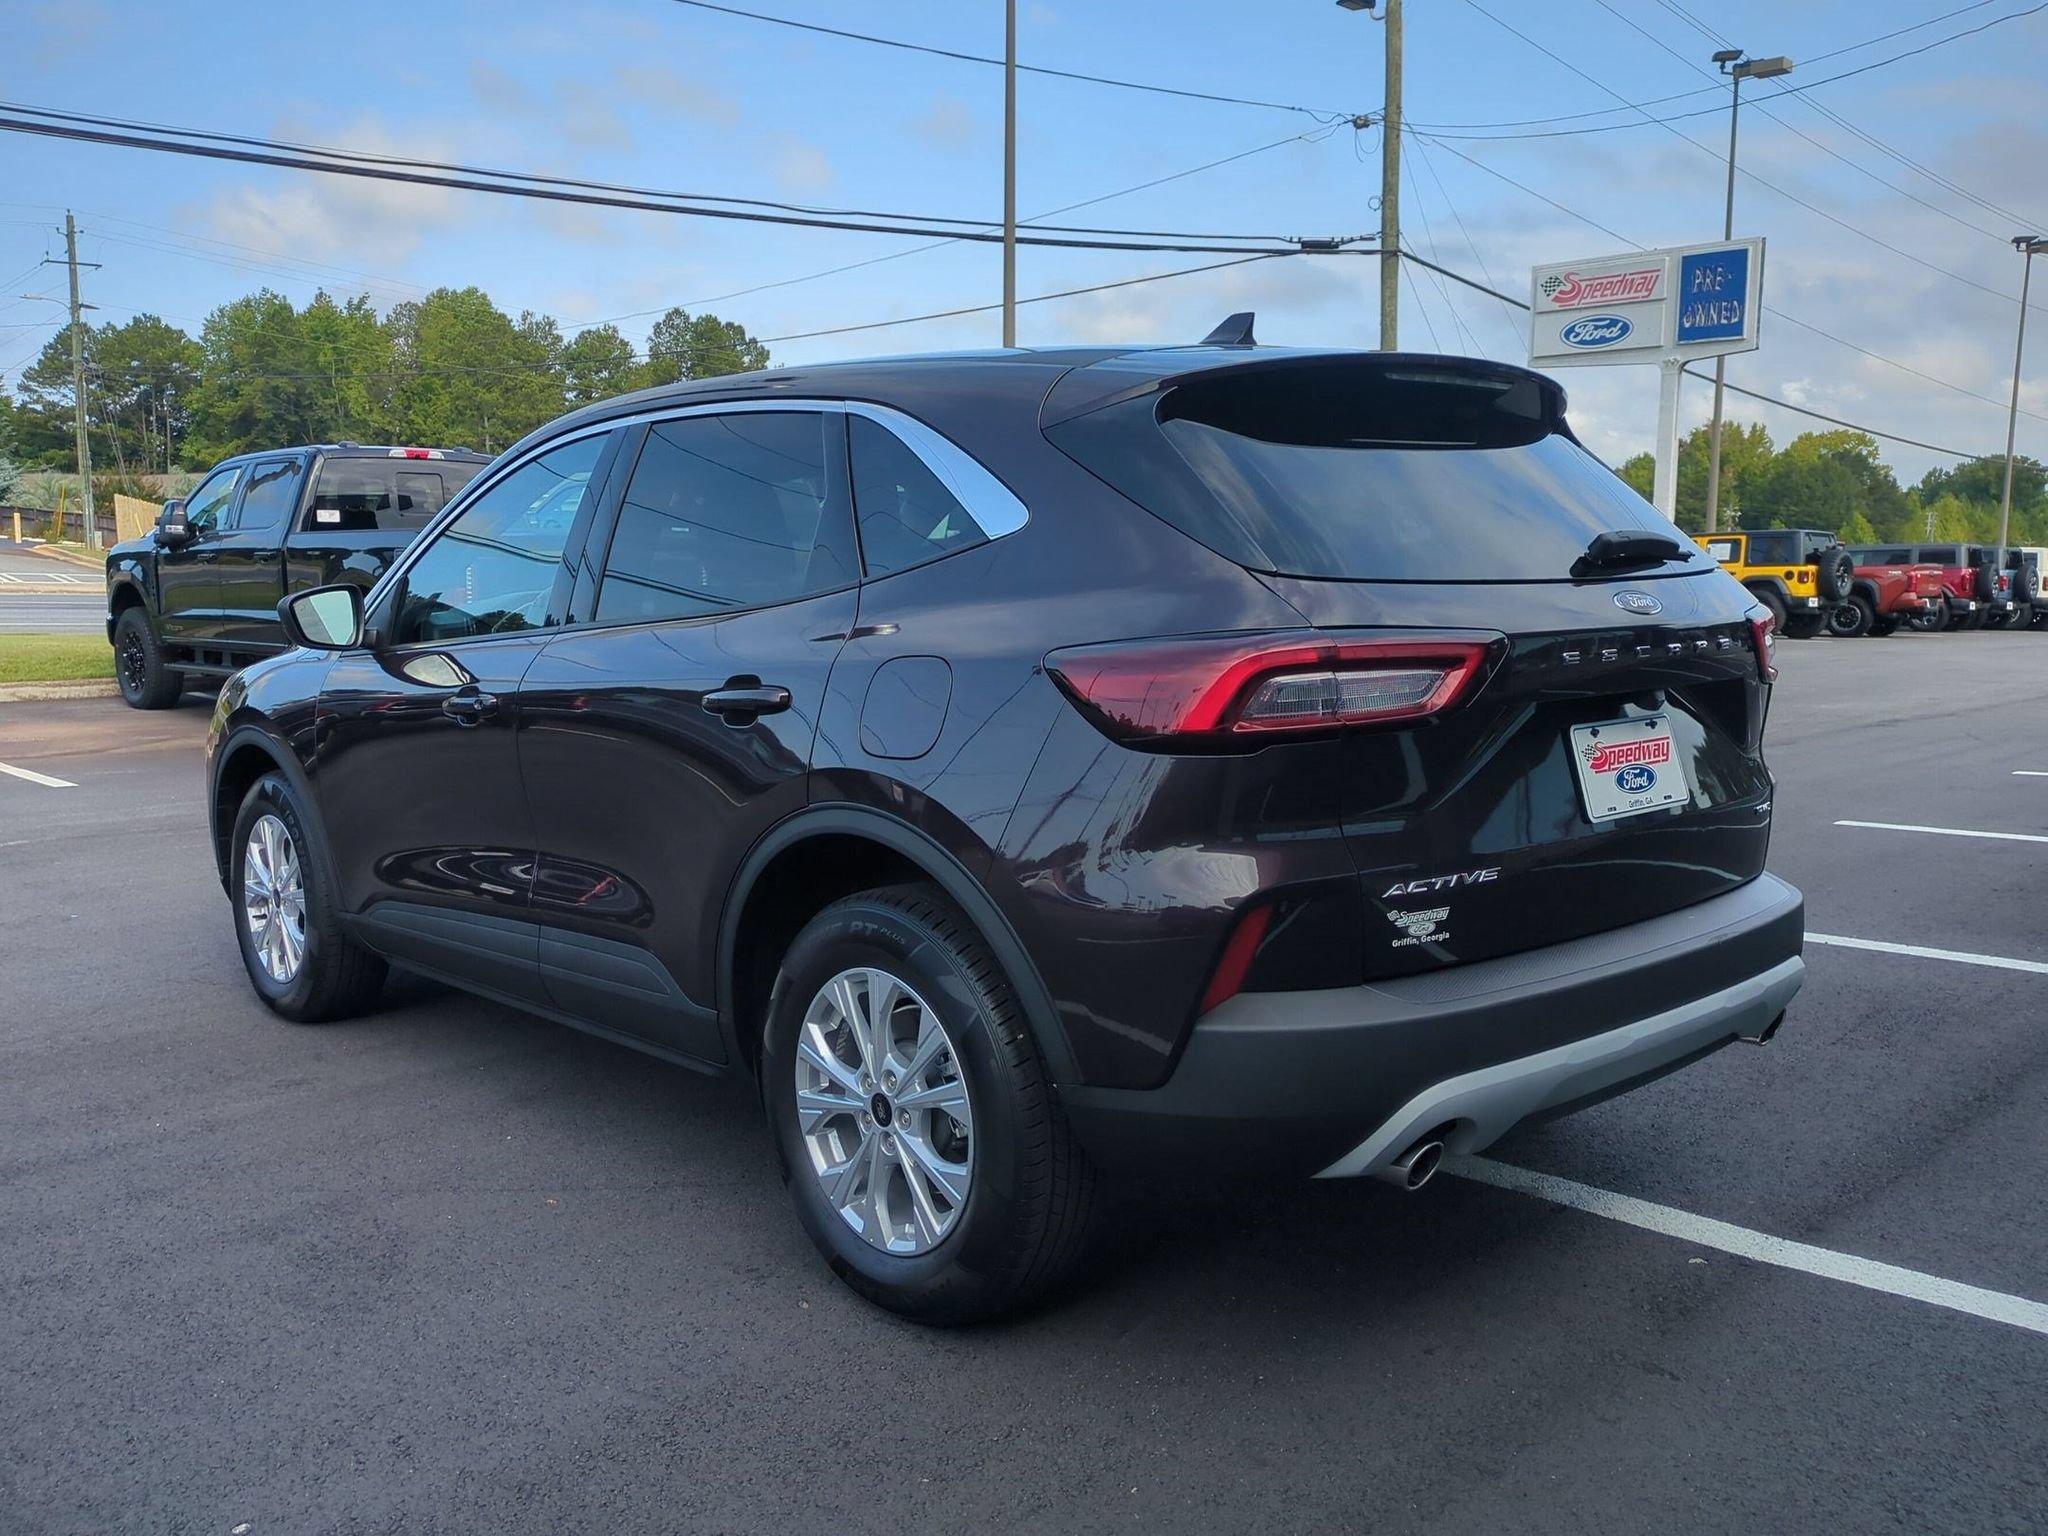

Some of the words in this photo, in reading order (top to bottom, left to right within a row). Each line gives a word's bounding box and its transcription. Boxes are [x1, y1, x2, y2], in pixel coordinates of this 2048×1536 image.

[1551, 269, 1661, 307] Speedway
[1682, 300, 1740, 330] OWNED
[1568, 318, 1623, 345] Ford
[1626, 593, 1654, 608] Ford
[1590, 738, 1670, 772] Speedway
[1623, 768, 1650, 790] Ford
[1381, 866, 1502, 898] ACTIVE
[1394, 908, 1450, 927] Speedway
[1421, 931, 1450, 943] Georgia
